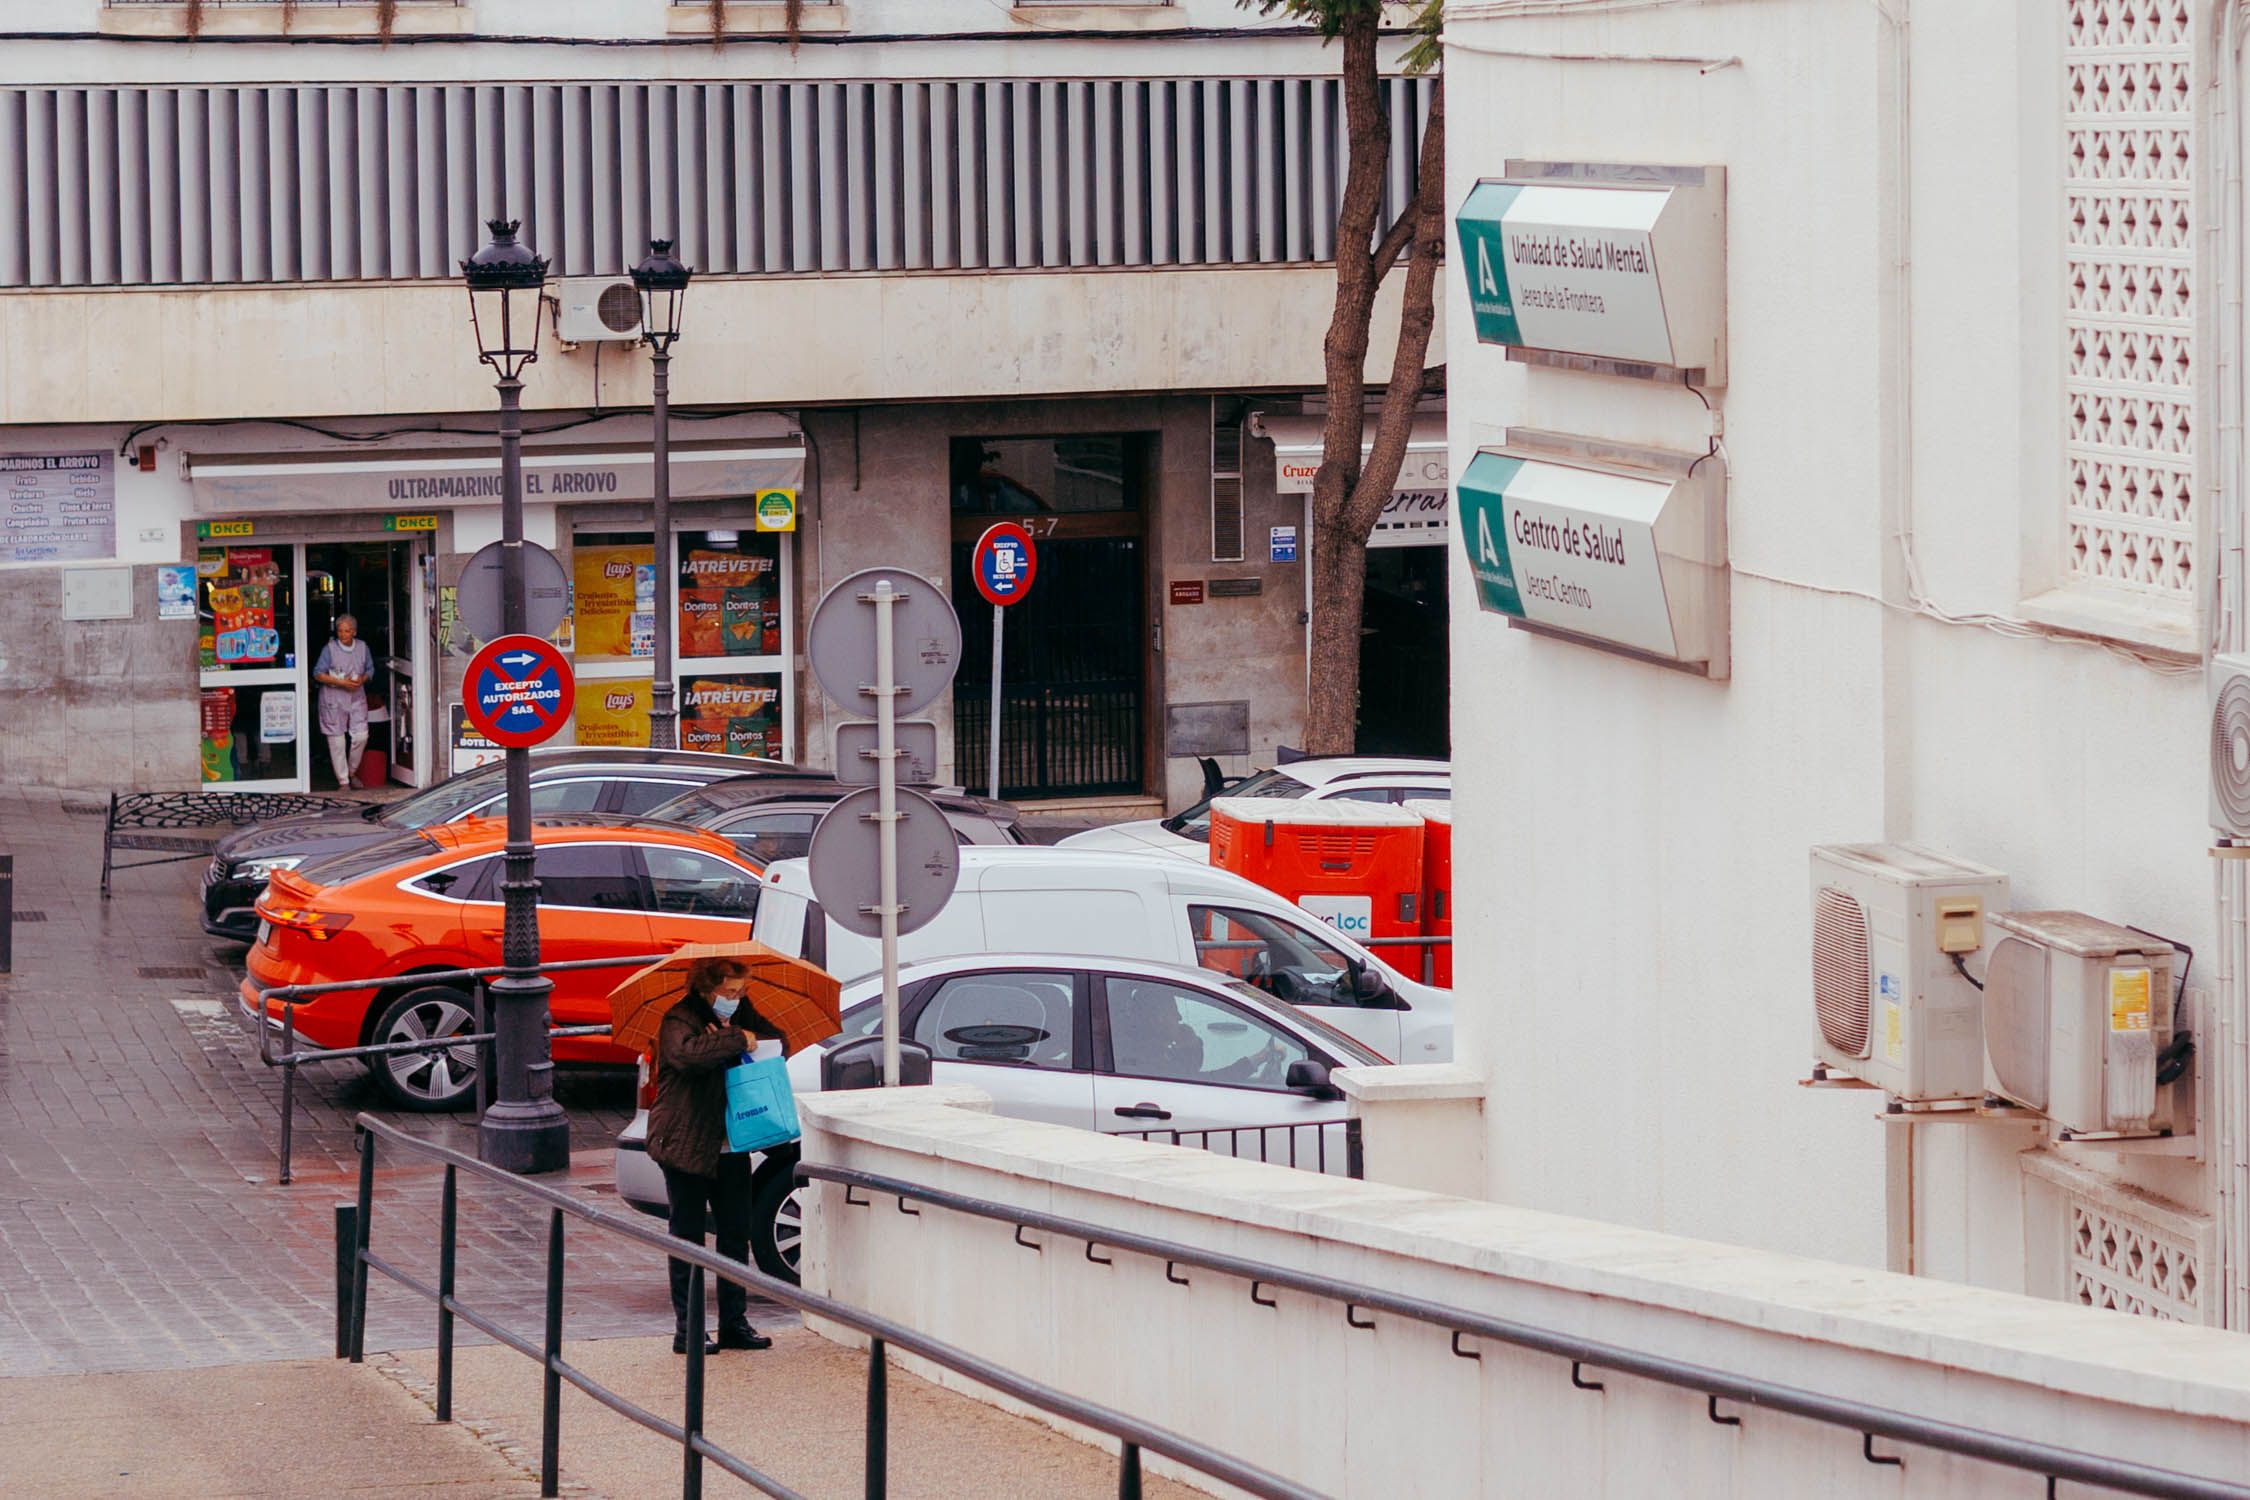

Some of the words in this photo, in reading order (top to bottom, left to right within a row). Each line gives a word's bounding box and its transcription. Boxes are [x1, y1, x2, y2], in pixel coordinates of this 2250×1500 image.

[1512, 235, 1551, 266] Unidad
[1554, 238, 1568, 268] de
[1570, 239, 1603, 270] Salud
[1605, 241, 1649, 274] Mental
[1520, 283, 1543, 309] Jerez
[1543, 285, 1554, 310] de
[1555, 286, 1564, 311] la
[1564, 287, 1605, 314] Frontera
[46, 458, 57, 469] EL
[59, 456, 98, 469] ARROYO
[1283, 464, 1319, 478] Cruzc
[1423, 462, 1448, 481] Ca
[388, 475, 503, 500] ULTRAMARINO
[526, 474, 544, 494] EL
[552, 472, 617, 494] ARROYO
[214, 523, 250, 534] ONCE
[399, 517, 434, 528] ONCE
[1514, 510, 1560, 552] Centro
[1562, 518, 1580, 556] de
[1583, 523, 1625, 565] Salud
[681, 558, 774, 574] ¡ATRÉVETE!
[1525, 569, 1554, 601] Jerez
[1553, 575, 1592, 609] Centro
[684, 602, 718, 612] Doritos
[726, 601, 760, 610] Doritos
[494, 680, 543, 691] EXCEPTO
[483, 689, 561, 704] AUTORIZADOS
[684, 688, 777, 705] ¡ATRÉVETE!
[511, 705, 534, 715] SAS
[460, 738, 485, 747] BOTE
[688, 733, 722, 743] Doritos
[730, 732, 764, 741] Doritos
[736, 1105, 768, 1121] Aromas
